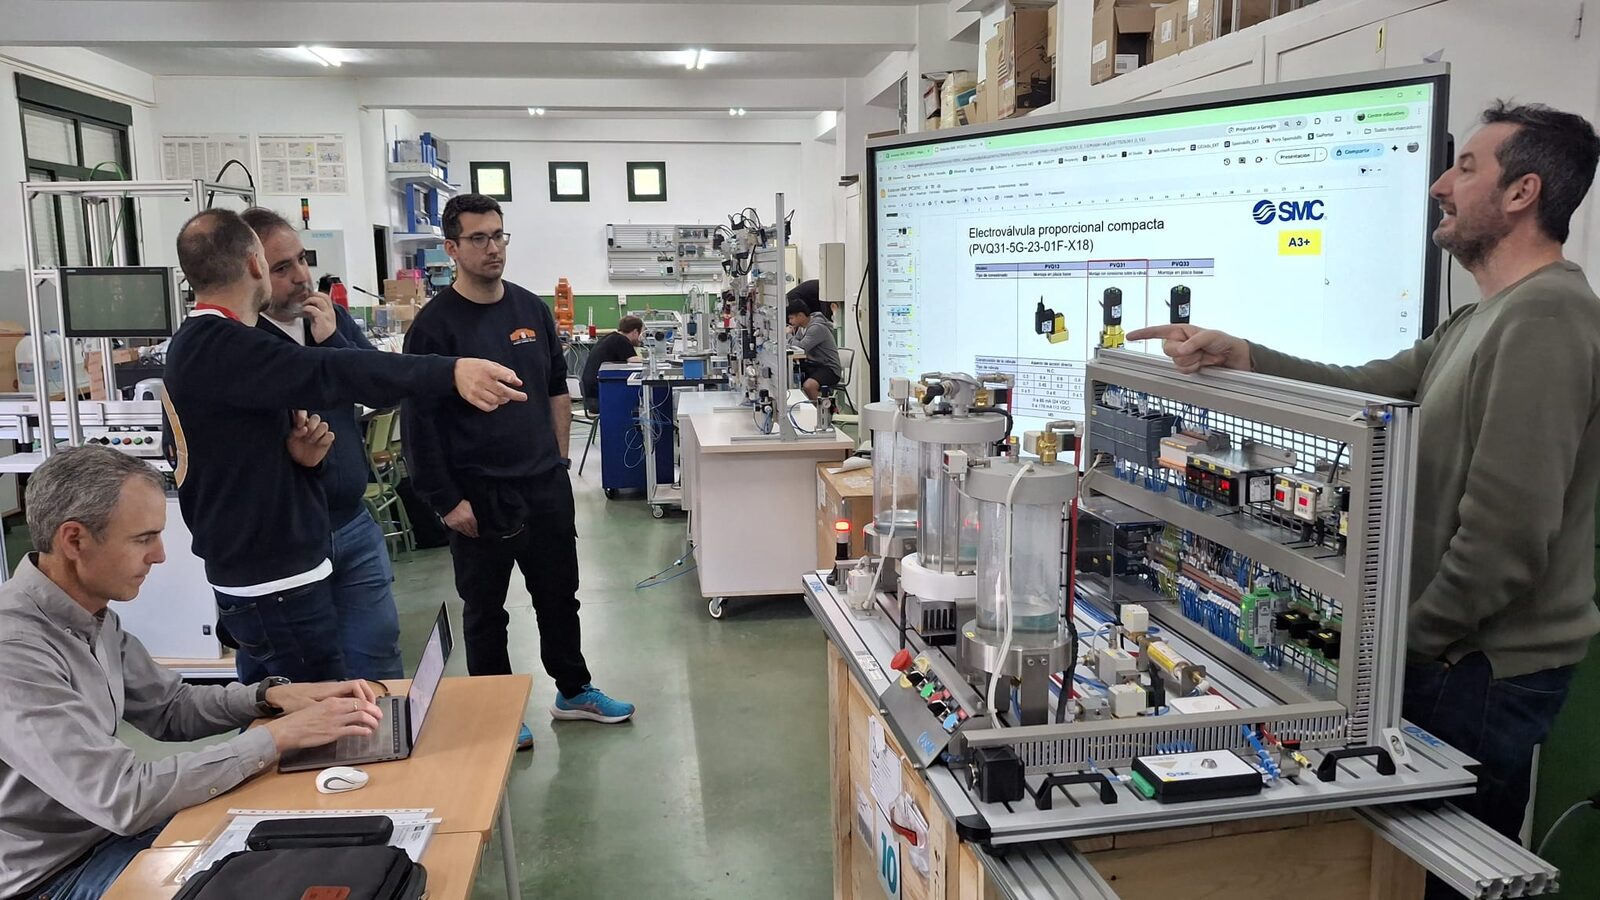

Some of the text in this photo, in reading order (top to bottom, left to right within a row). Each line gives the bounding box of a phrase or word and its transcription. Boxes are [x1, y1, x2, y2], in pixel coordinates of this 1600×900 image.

[1260, 123, 1277, 131] Google
[1278, 199, 1324, 221] SMC
[969, 217, 1165, 239] Electroválvula proporcional compacta
[968, 239, 1094, 256] (PVQ31-5G-23-01F-X18)
[1288, 237, 1310, 247] A3+
